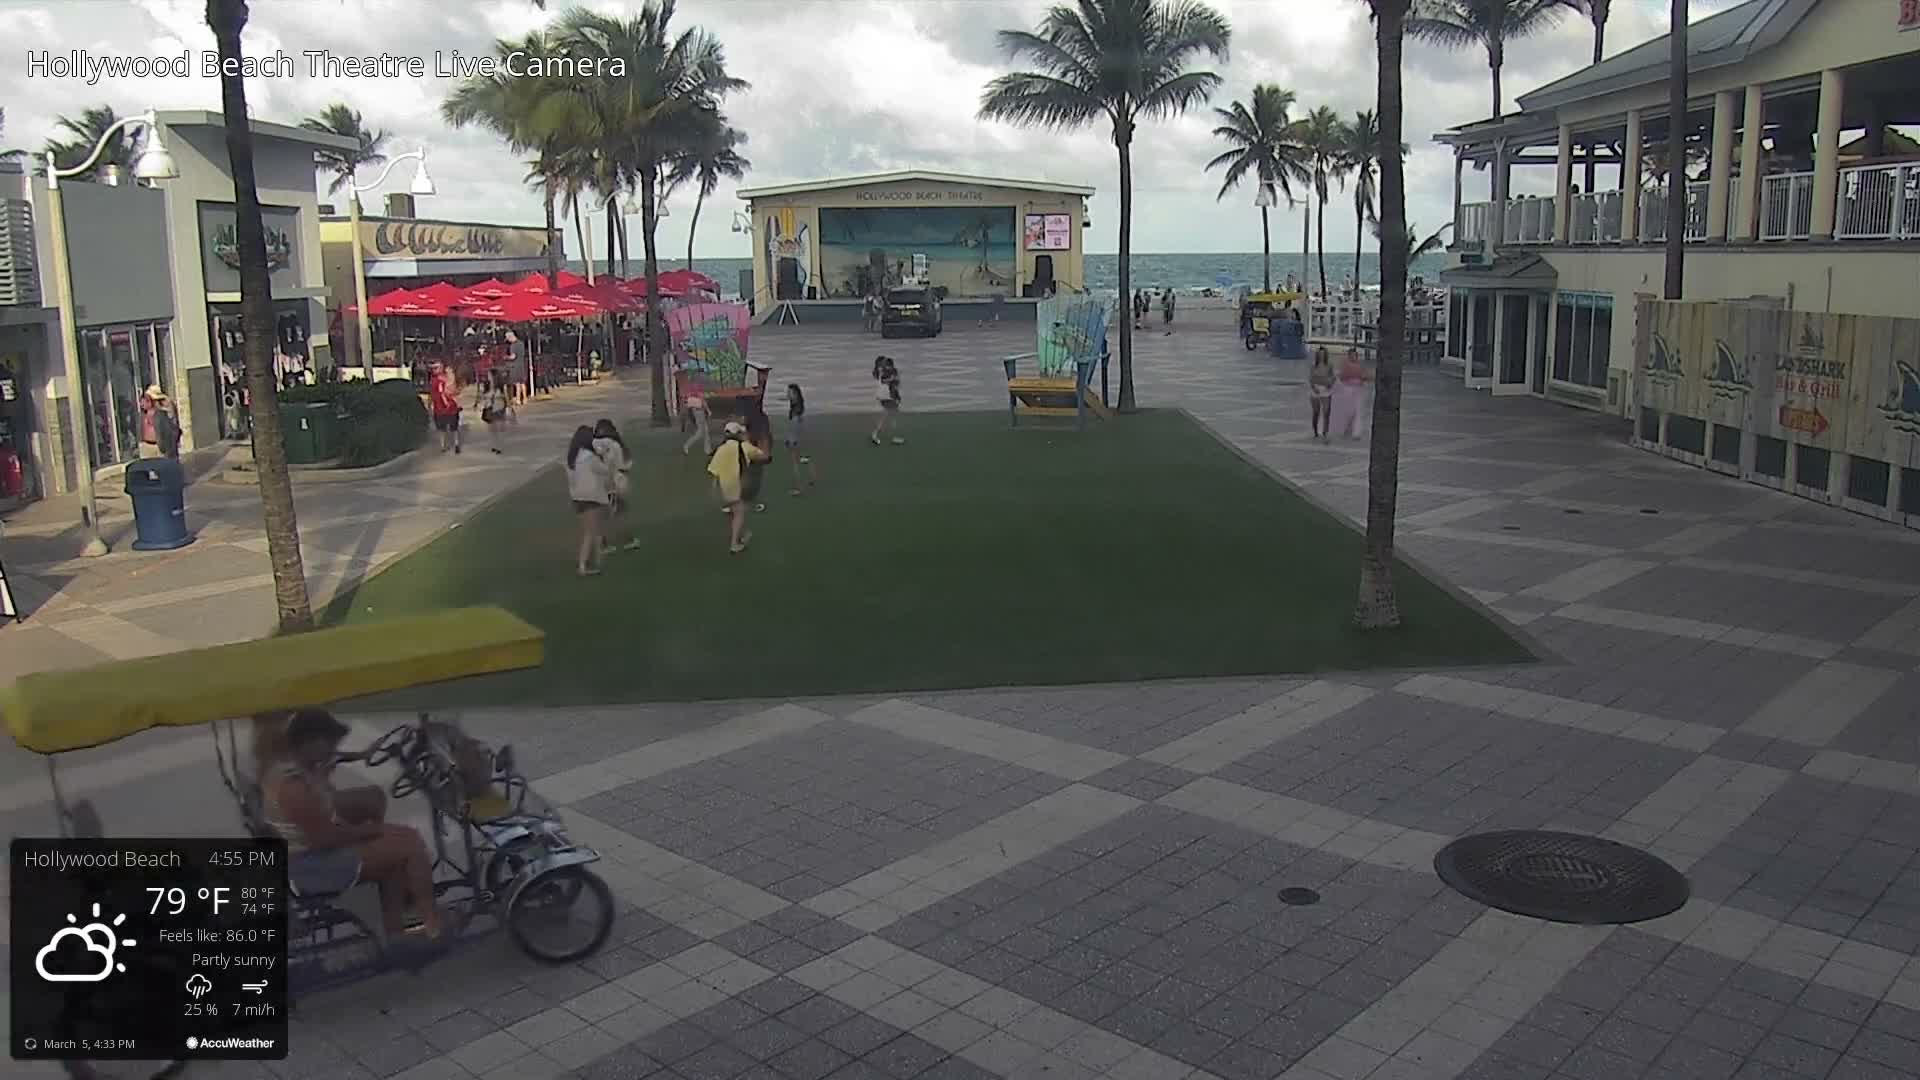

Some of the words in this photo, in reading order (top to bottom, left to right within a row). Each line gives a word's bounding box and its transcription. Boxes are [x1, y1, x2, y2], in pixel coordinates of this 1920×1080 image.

[856, 191, 912, 201] HOLLYWOOD
[916, 191, 941, 201] BEACH
[948, 191, 983, 201] THEATRE
